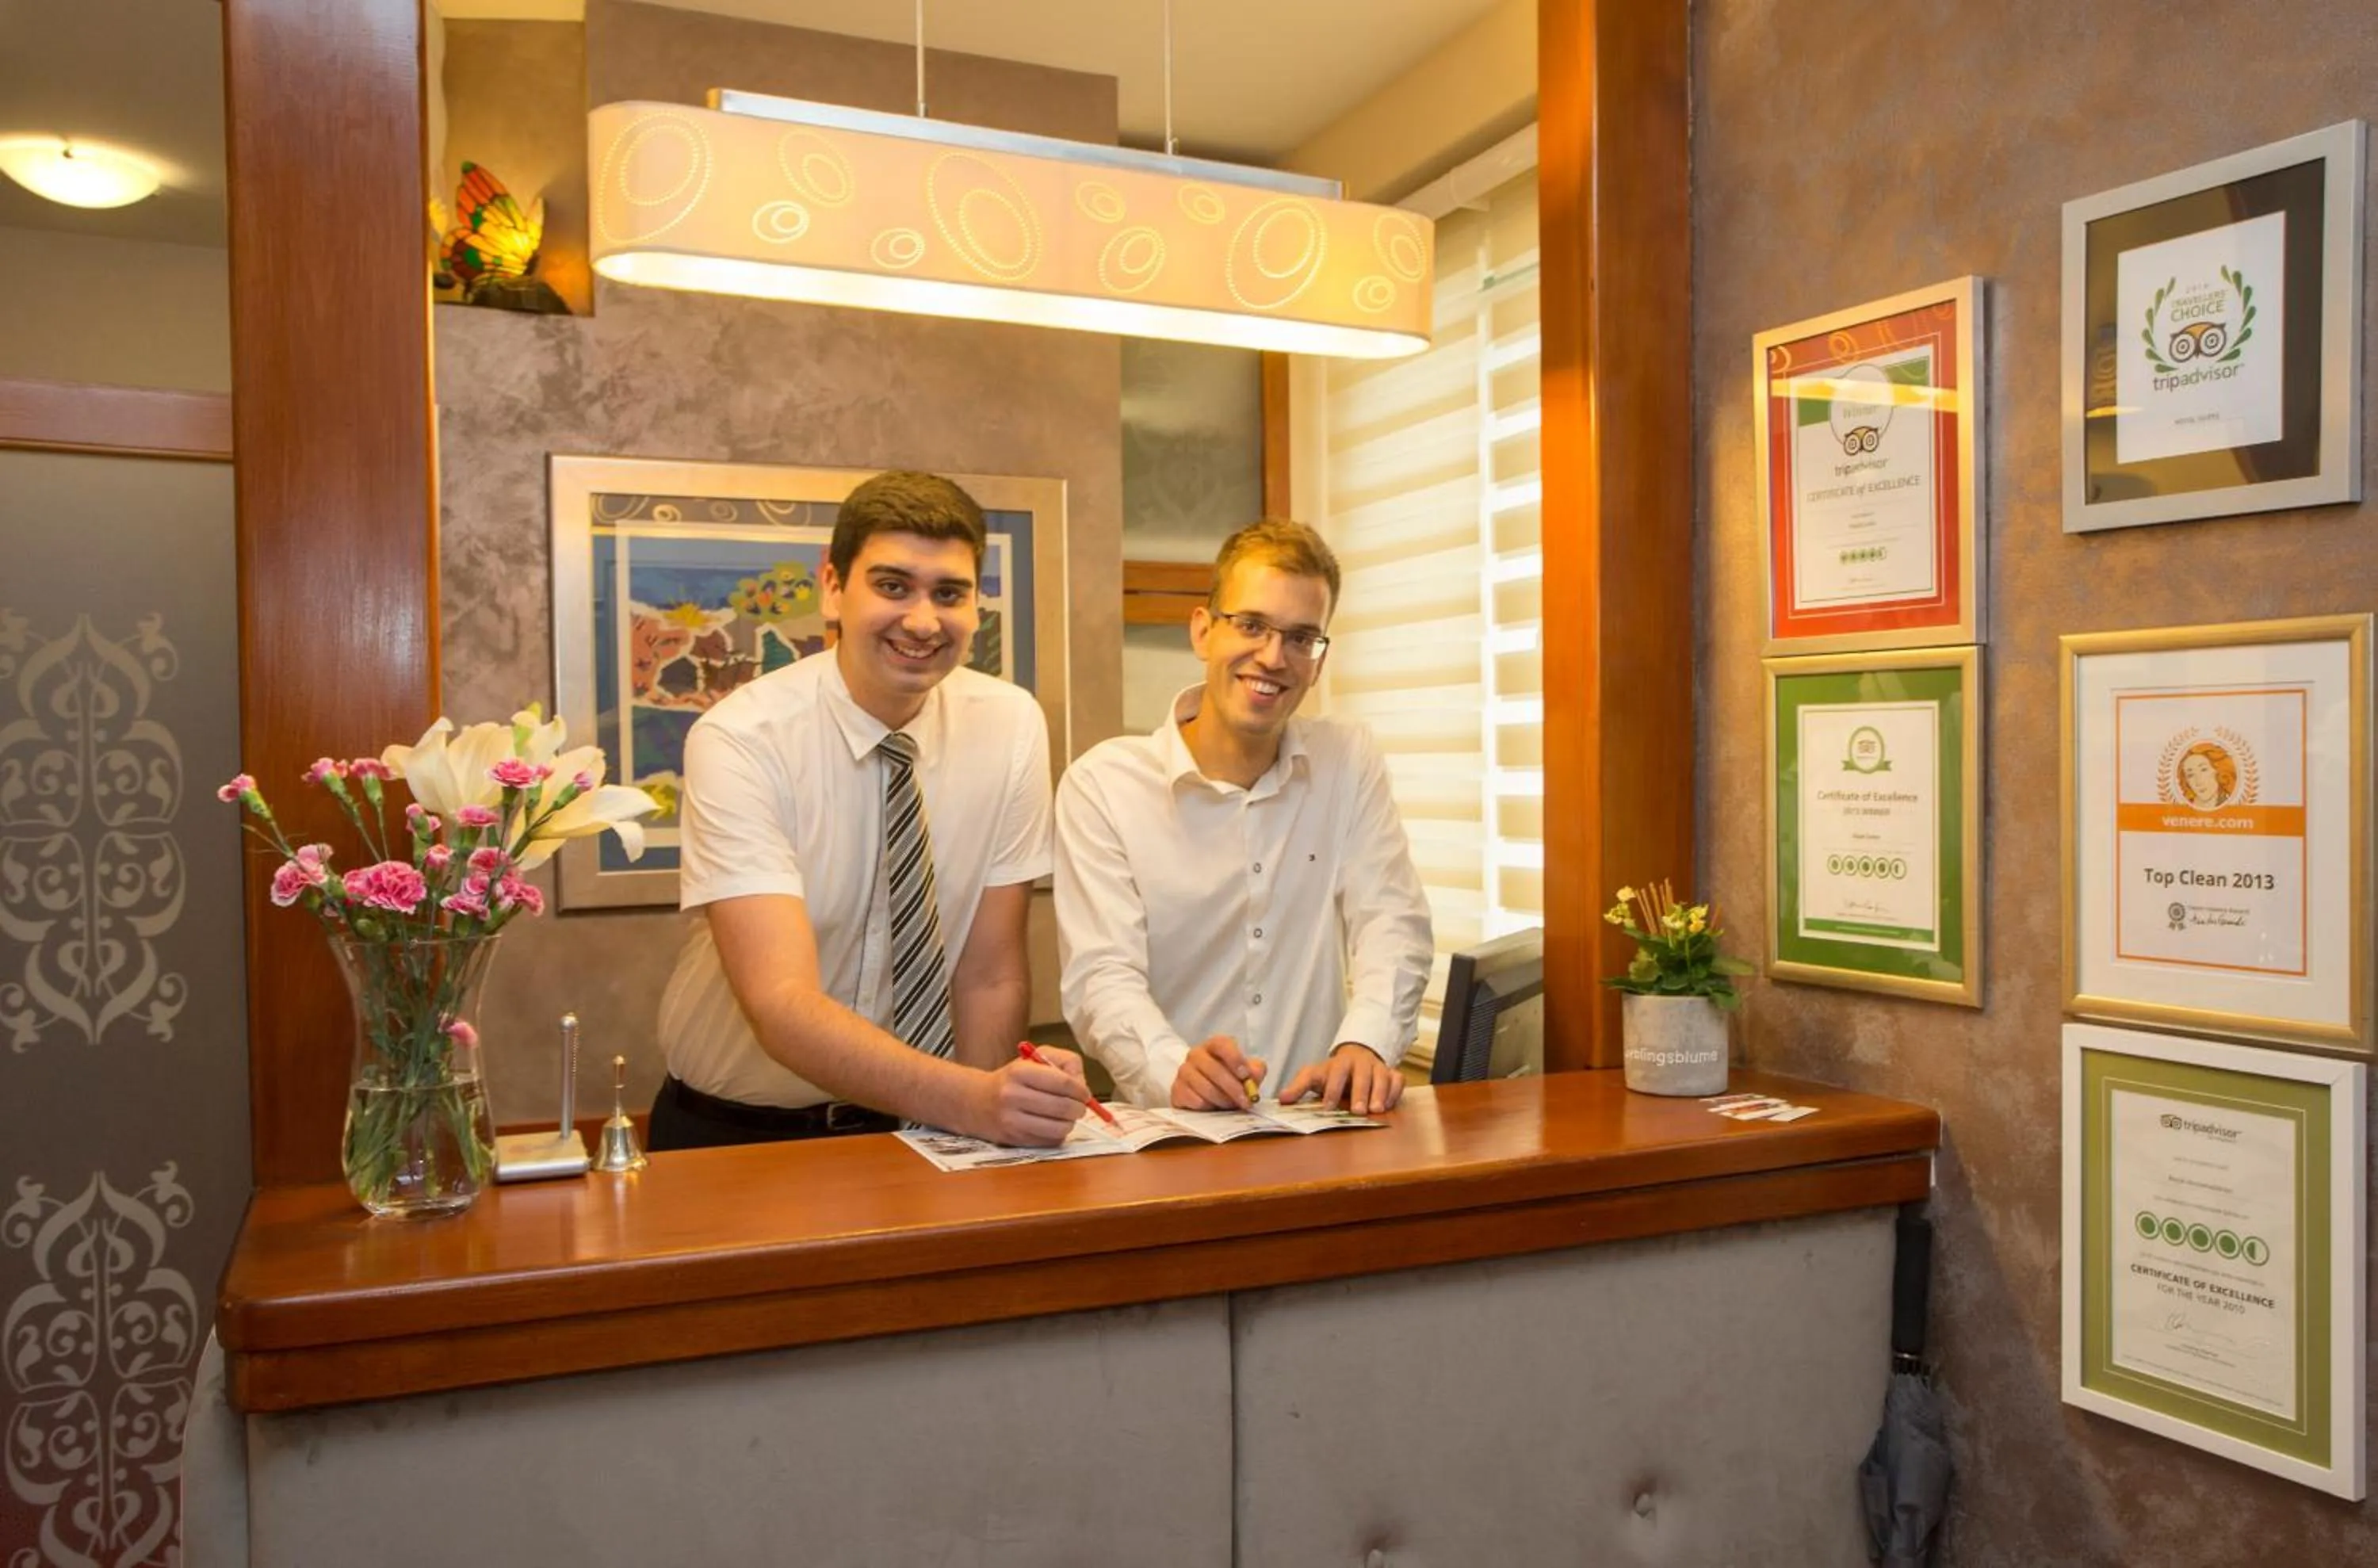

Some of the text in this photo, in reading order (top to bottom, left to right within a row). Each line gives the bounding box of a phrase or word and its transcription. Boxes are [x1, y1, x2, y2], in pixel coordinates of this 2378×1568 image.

[2170, 299, 2226, 323] CHOICE
[2152, 364, 2239, 393] tripadvisor
[1868, 476, 1921, 493] EXCELLENCE
[1817, 790, 1918, 803] Certificate of Excellence
[2162, 816, 2254, 829] venere.com
[2143, 867, 2275, 890] Top Clean 2013
[2183, 1119, 2238, 1138] tripadvisor
[2130, 1264, 2190, 1287] CERTIFICATE
[2193, 1280, 2207, 1290] OF
[2209, 1283, 2276, 1309] EXCELLENCE
[2157, 1283, 2174, 1295] FOR
[2176, 1288, 2193, 1302] THE
[2196, 1293, 2220, 1307] YEAR
